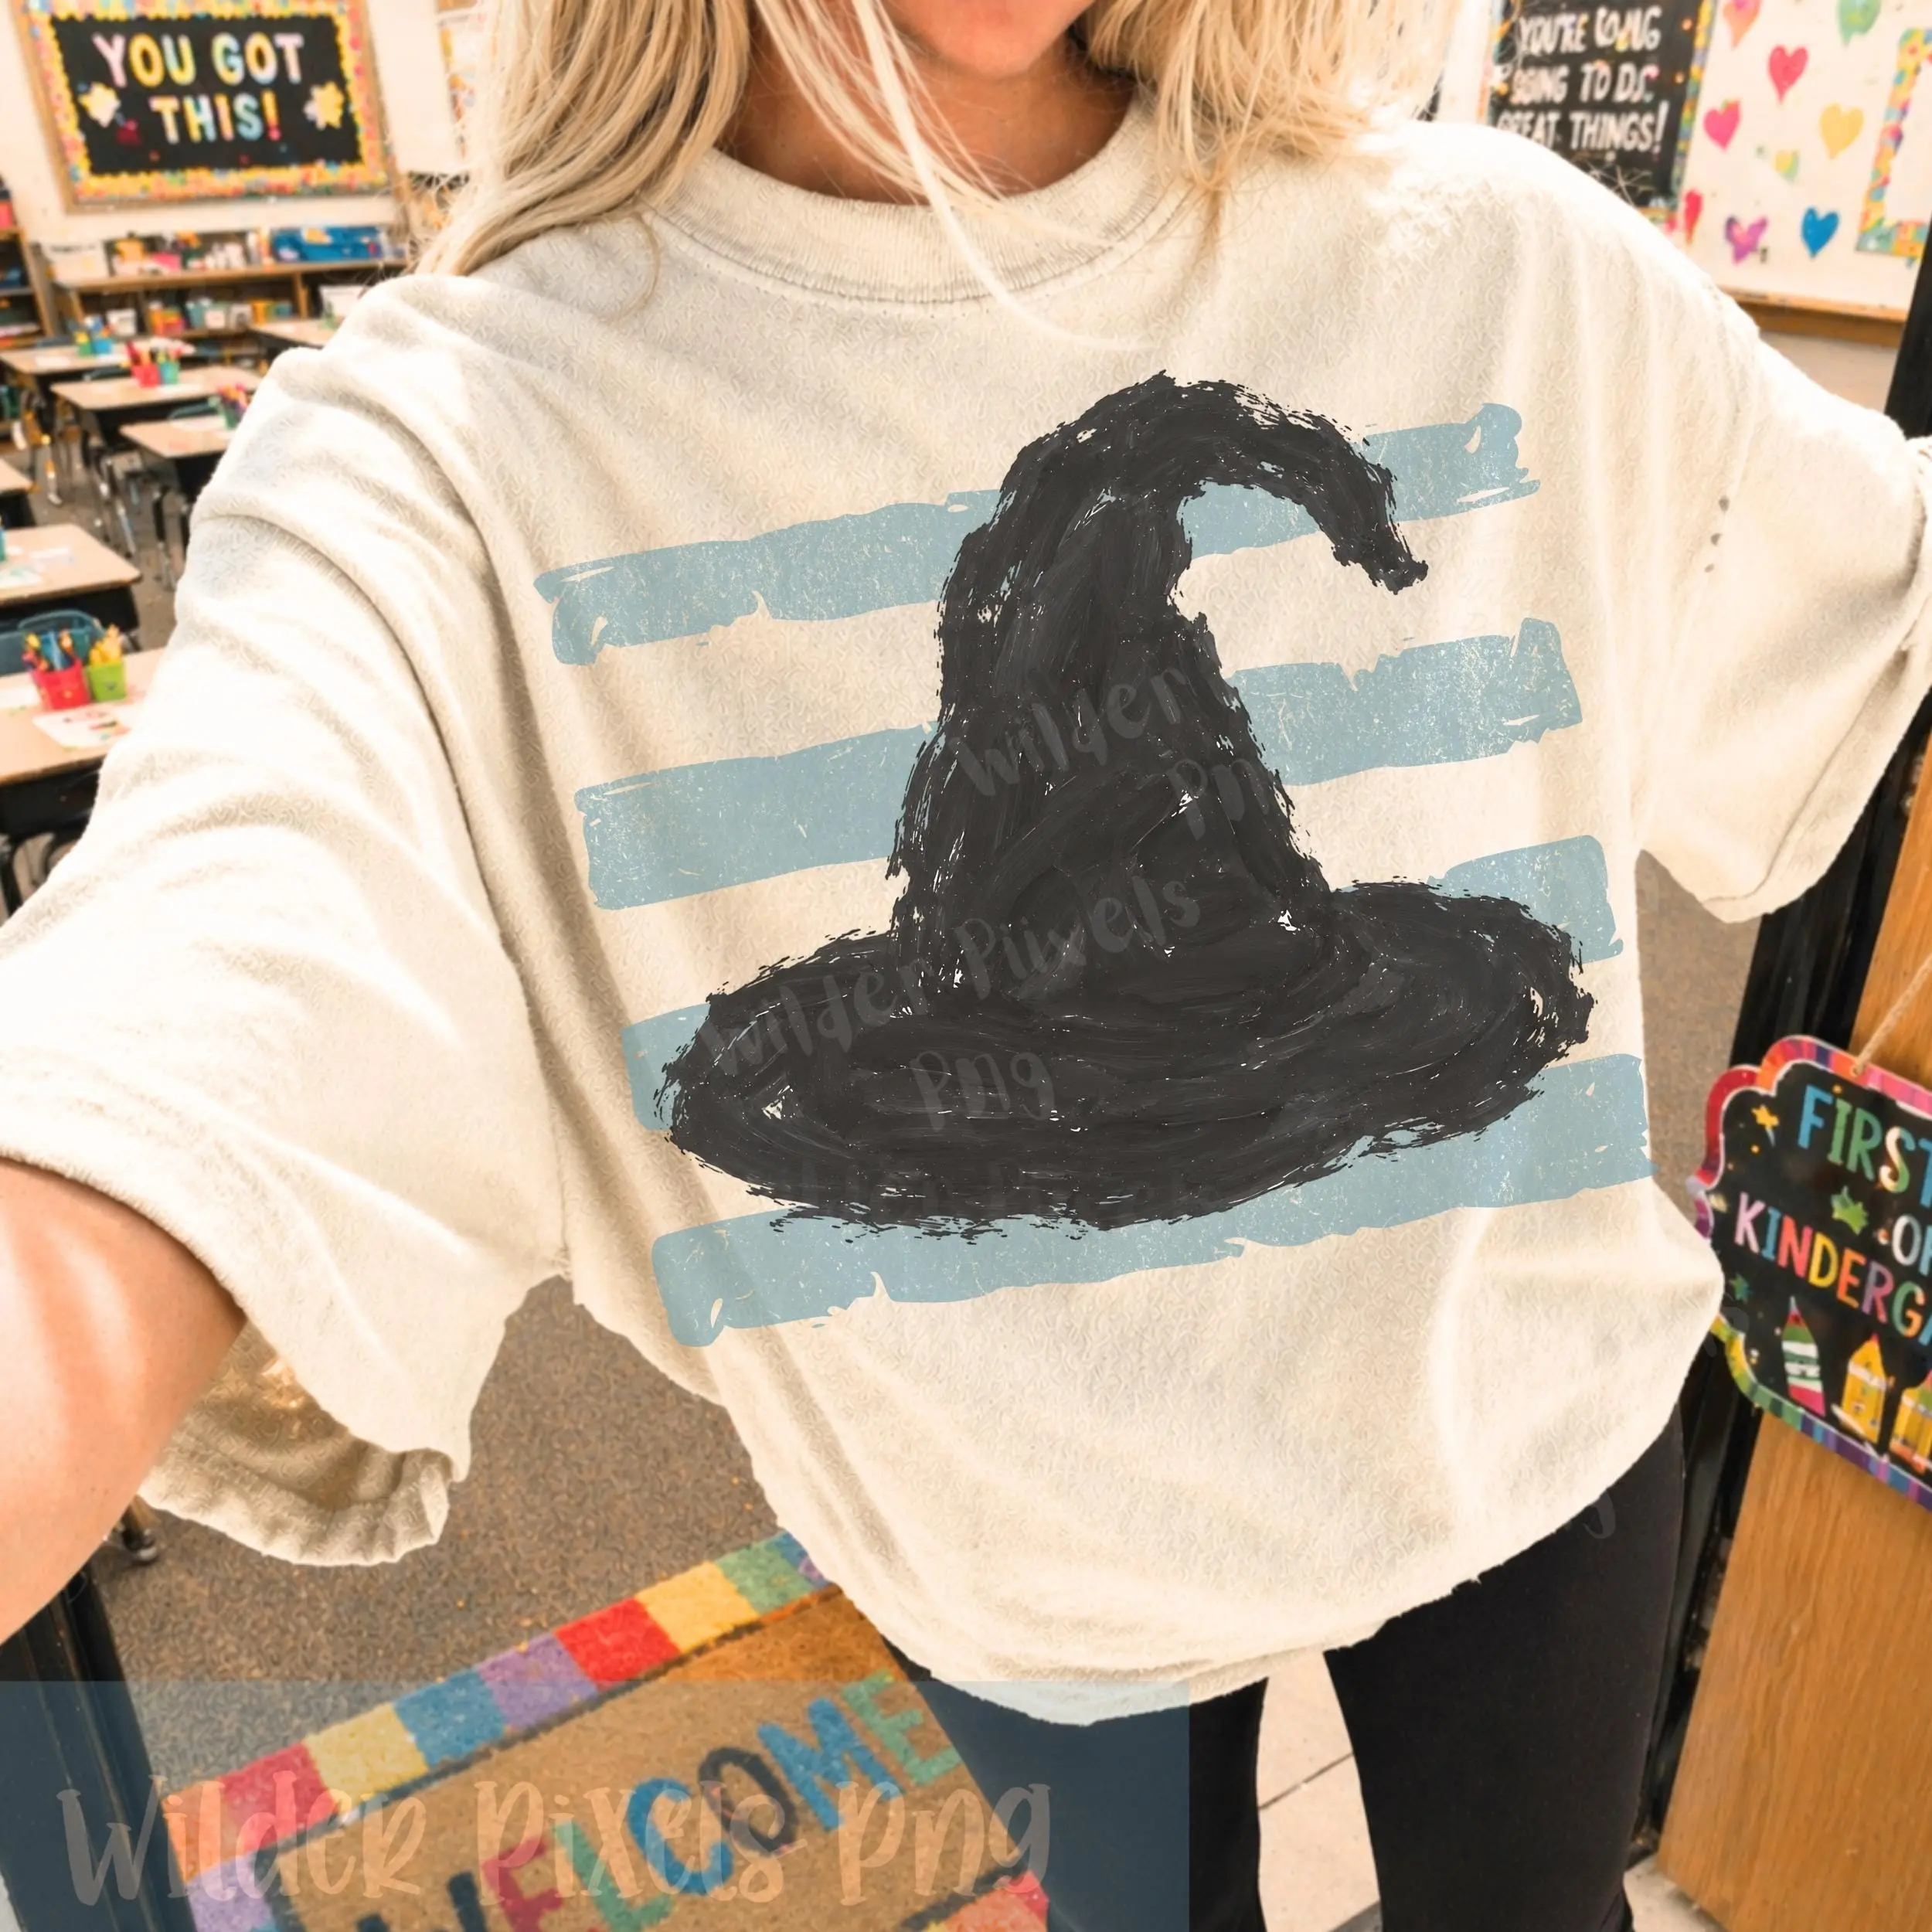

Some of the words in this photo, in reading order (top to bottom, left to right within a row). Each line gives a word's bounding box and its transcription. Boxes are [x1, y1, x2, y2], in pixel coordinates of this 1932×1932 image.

[91, 32, 196, 87] YOU
[211, 32, 304, 87] GOT
[1580, 60, 1612, 102] TO
[148, 89, 281, 144] THIS!
[1569, 100, 1669, 155] THINGS!
[1734, 1192, 1932, 1345] KINDERG
